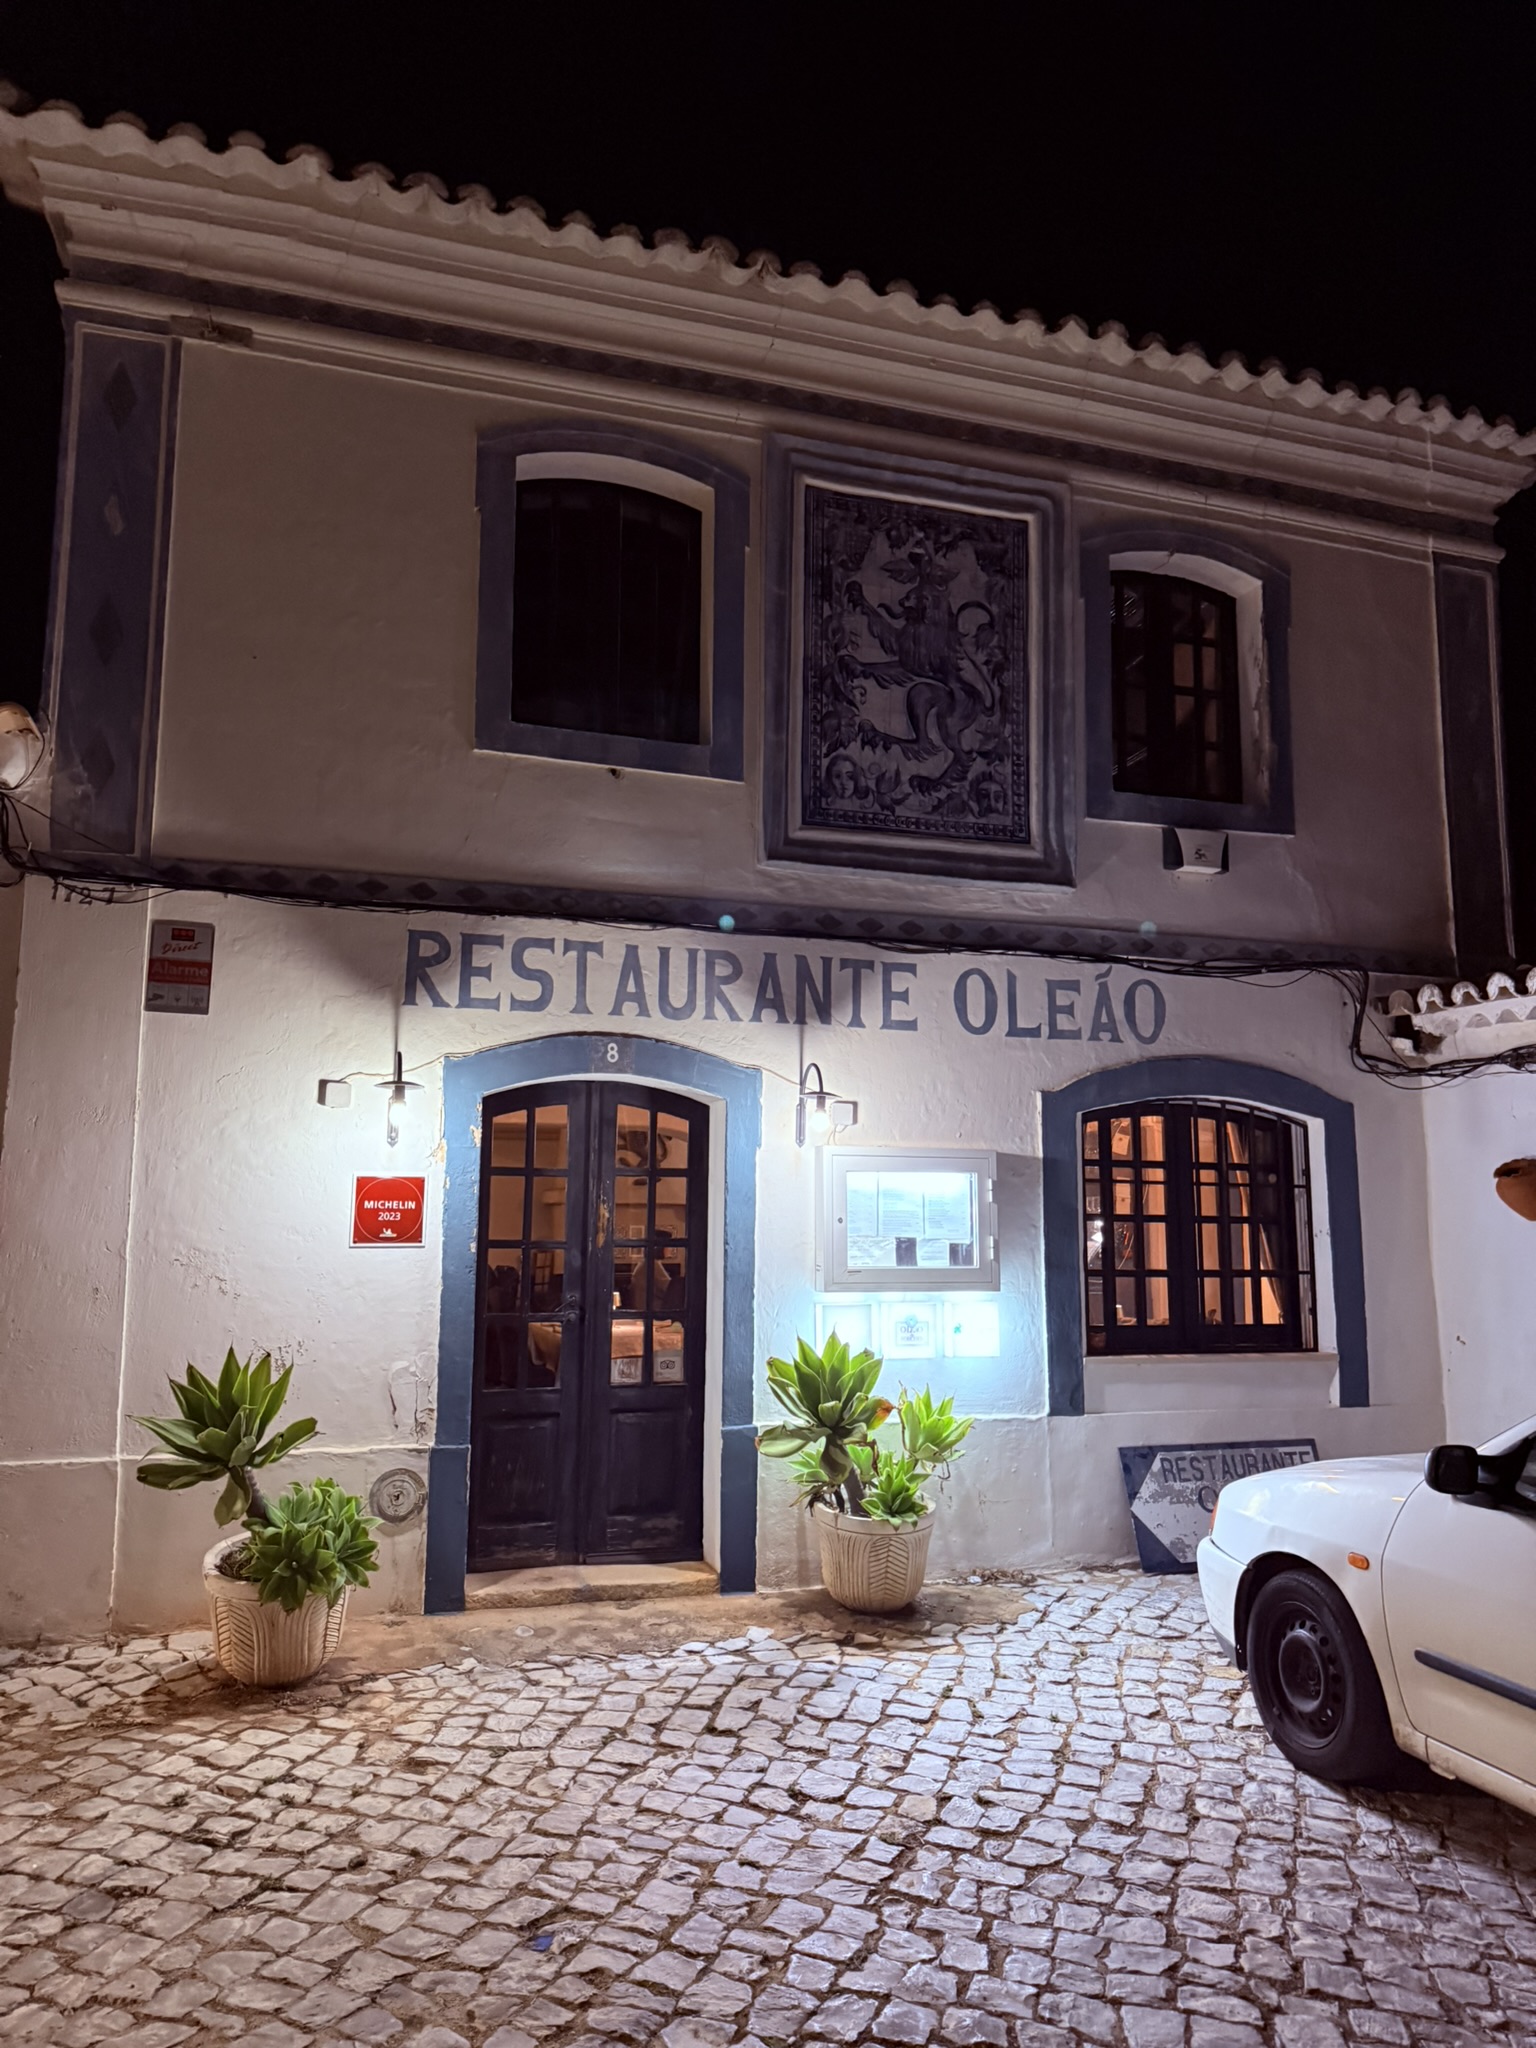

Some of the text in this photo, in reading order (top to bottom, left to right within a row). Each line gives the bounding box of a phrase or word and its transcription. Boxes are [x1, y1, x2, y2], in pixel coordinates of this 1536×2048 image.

[152, 962, 209, 976] Alarme
[401, 929, 919, 1031] RESTAURANTE
[607, 1043, 619, 1063] 8
[364, 1201, 415, 1209] MICHELIN
[378, 1212, 401, 1220] 2023
